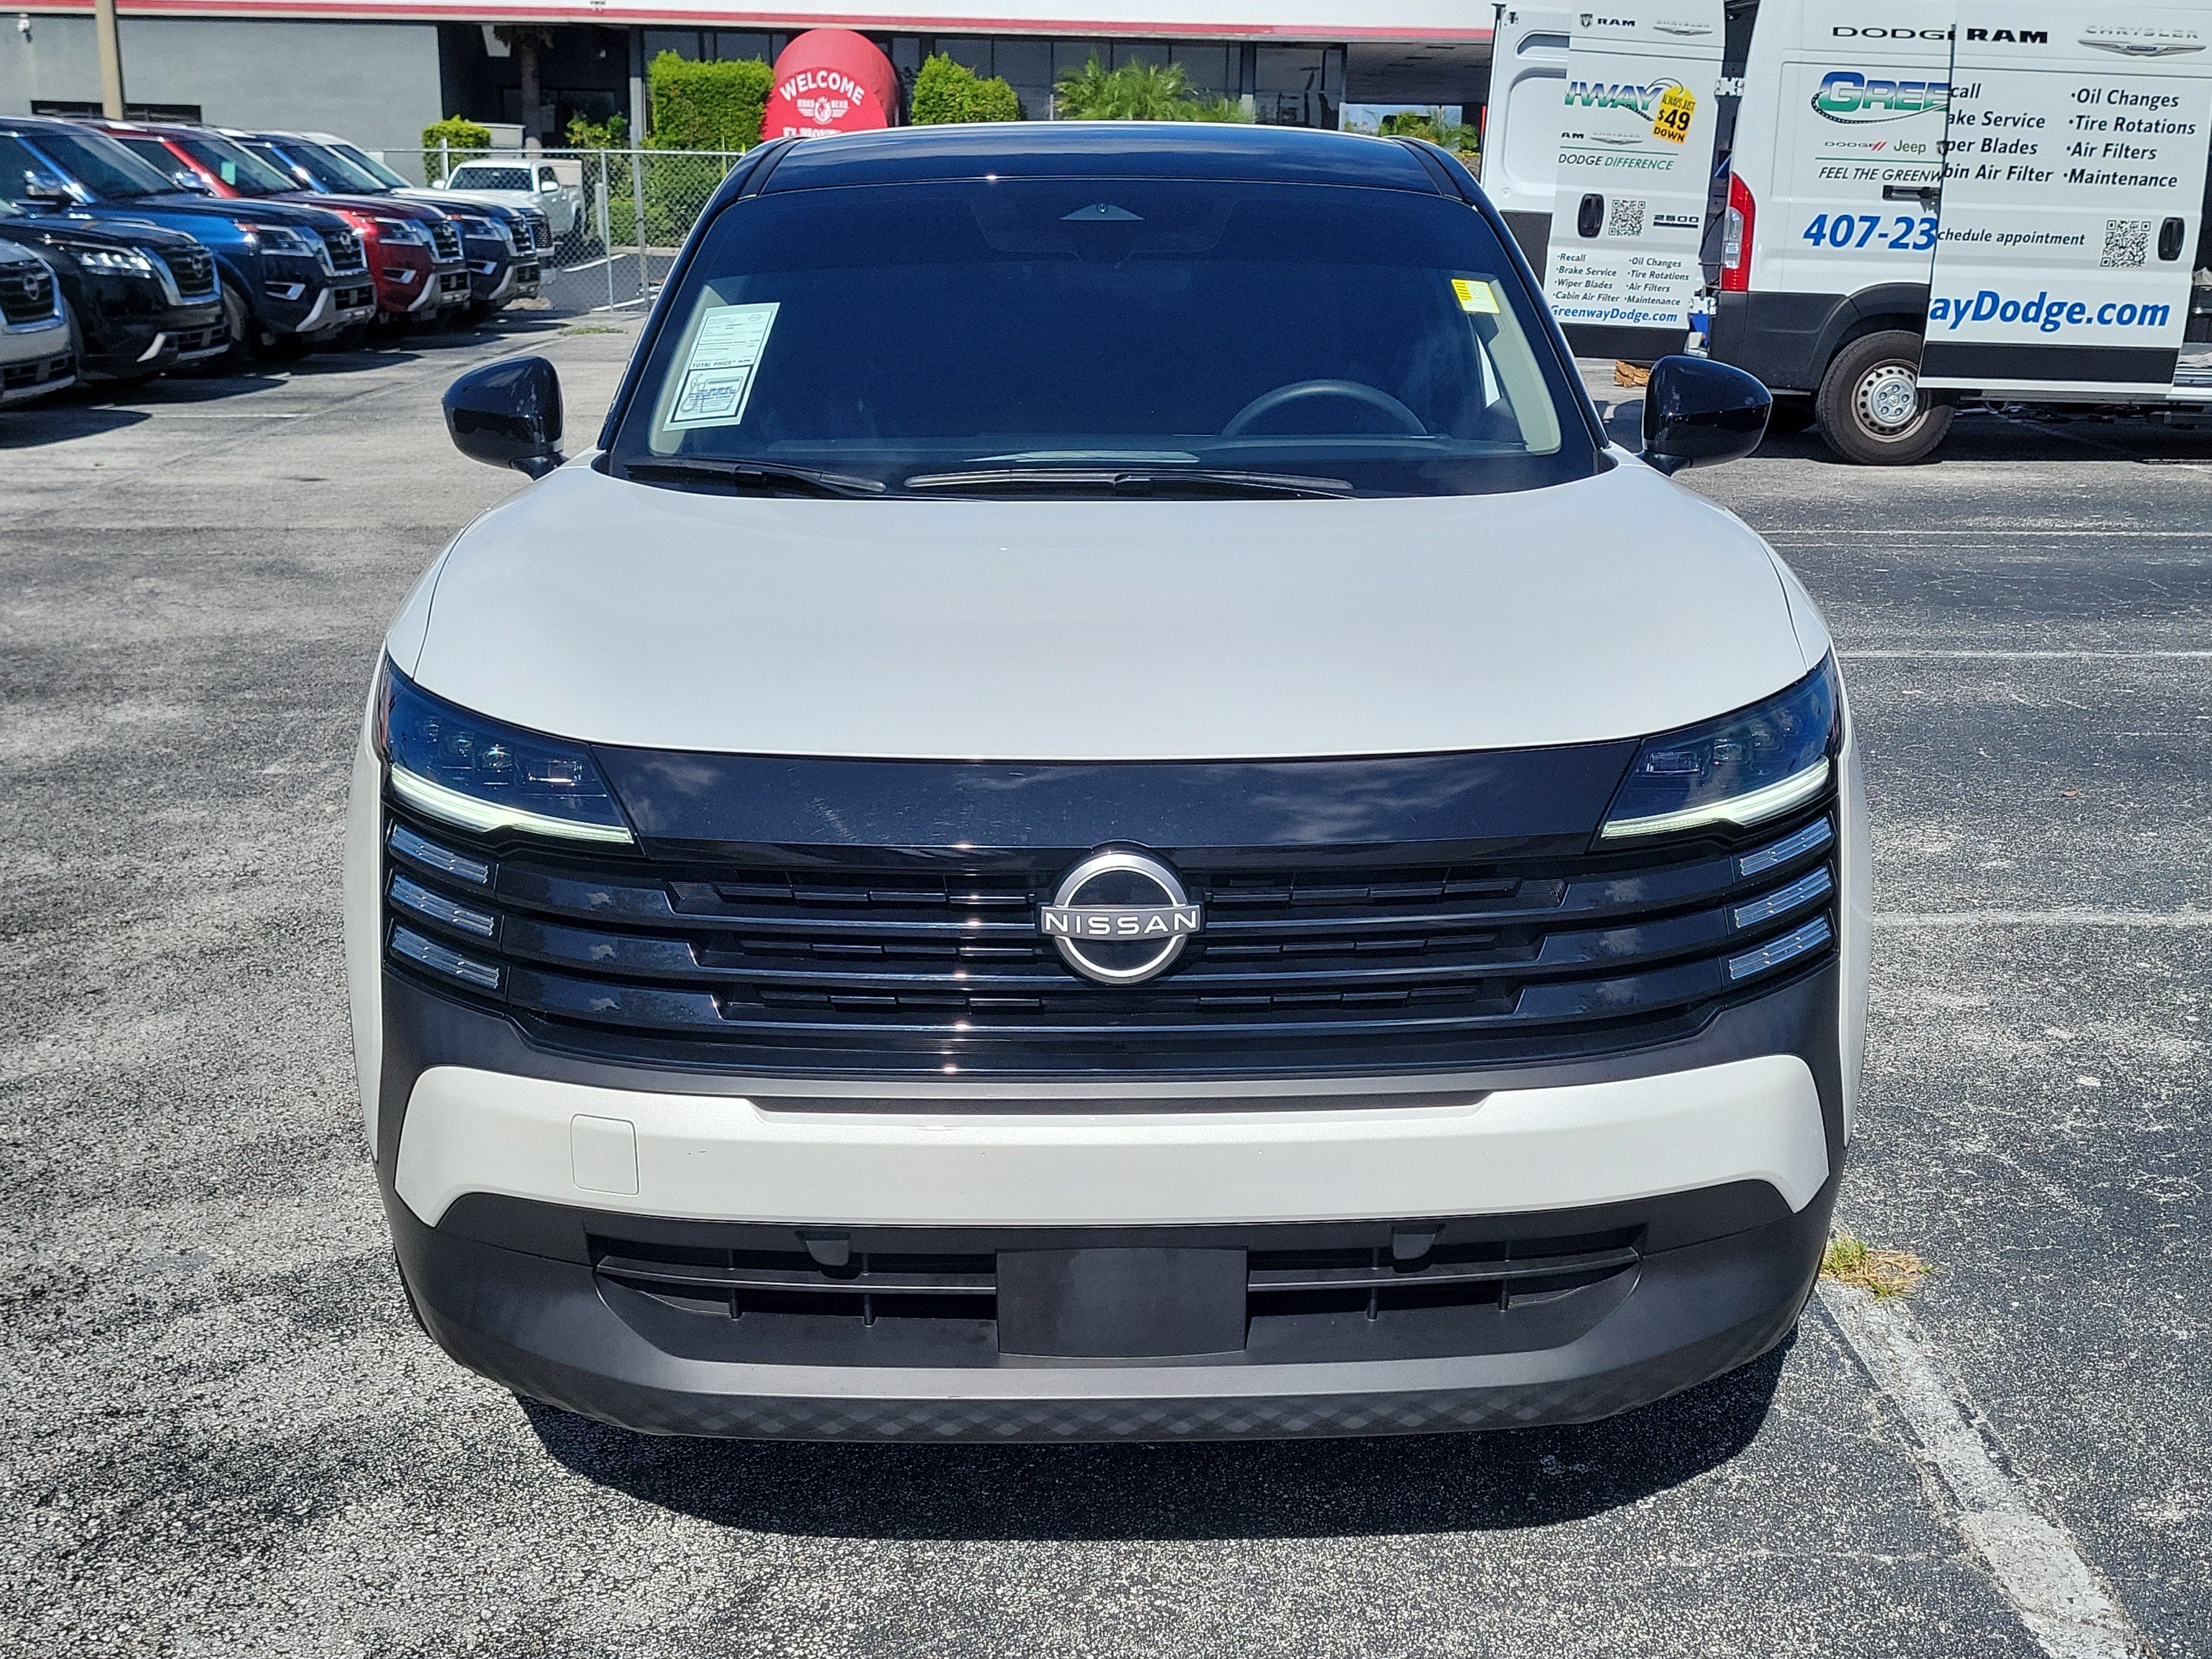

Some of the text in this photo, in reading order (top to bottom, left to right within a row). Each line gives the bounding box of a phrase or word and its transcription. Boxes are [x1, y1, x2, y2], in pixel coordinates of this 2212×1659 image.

[1598, 18, 1635, 27] RAM
[1967, 28, 2047, 44] RAM
[2086, 26, 2198, 38] CHRYSLER
[779, 70, 865, 106] WELCOME
[1662, 94, 1696, 111] ALWAYS JUST
[2107, 90, 2180, 111] Changes
[1657, 109, 1690, 131] $49
[1982, 111, 2045, 129] Service
[2113, 117, 2196, 135] Rotations
[1654, 127, 1685, 143] DOWN
[1894, 140, 1926, 155] Jeep
[1980, 138, 2038, 155] Blades
[2102, 143, 2157, 160] Filters
[1559, 154, 1674, 170] DODGE DIFFERENCE
[1819, 167, 1848, 179] FEEL
[1853, 168, 1879, 180] THE
[1975, 165, 2001, 180] Air
[2006, 165, 2053, 182] Filter
[1803, 214, 1938, 250] 407-23
[1996, 231, 2085, 246] appointment
[1646, 258, 1681, 269] Changes
[1585, 268, 1617, 276] Service
[1649, 271, 1689, 280] Rotations
[1584, 280, 1613, 289] Blades
[1644, 284, 1670, 292] Filters
[1597, 294, 1620, 302] Filter
[1929, 290, 2170, 332] ayDodge.com
[1046, 911, 1196, 935] NISSAN
